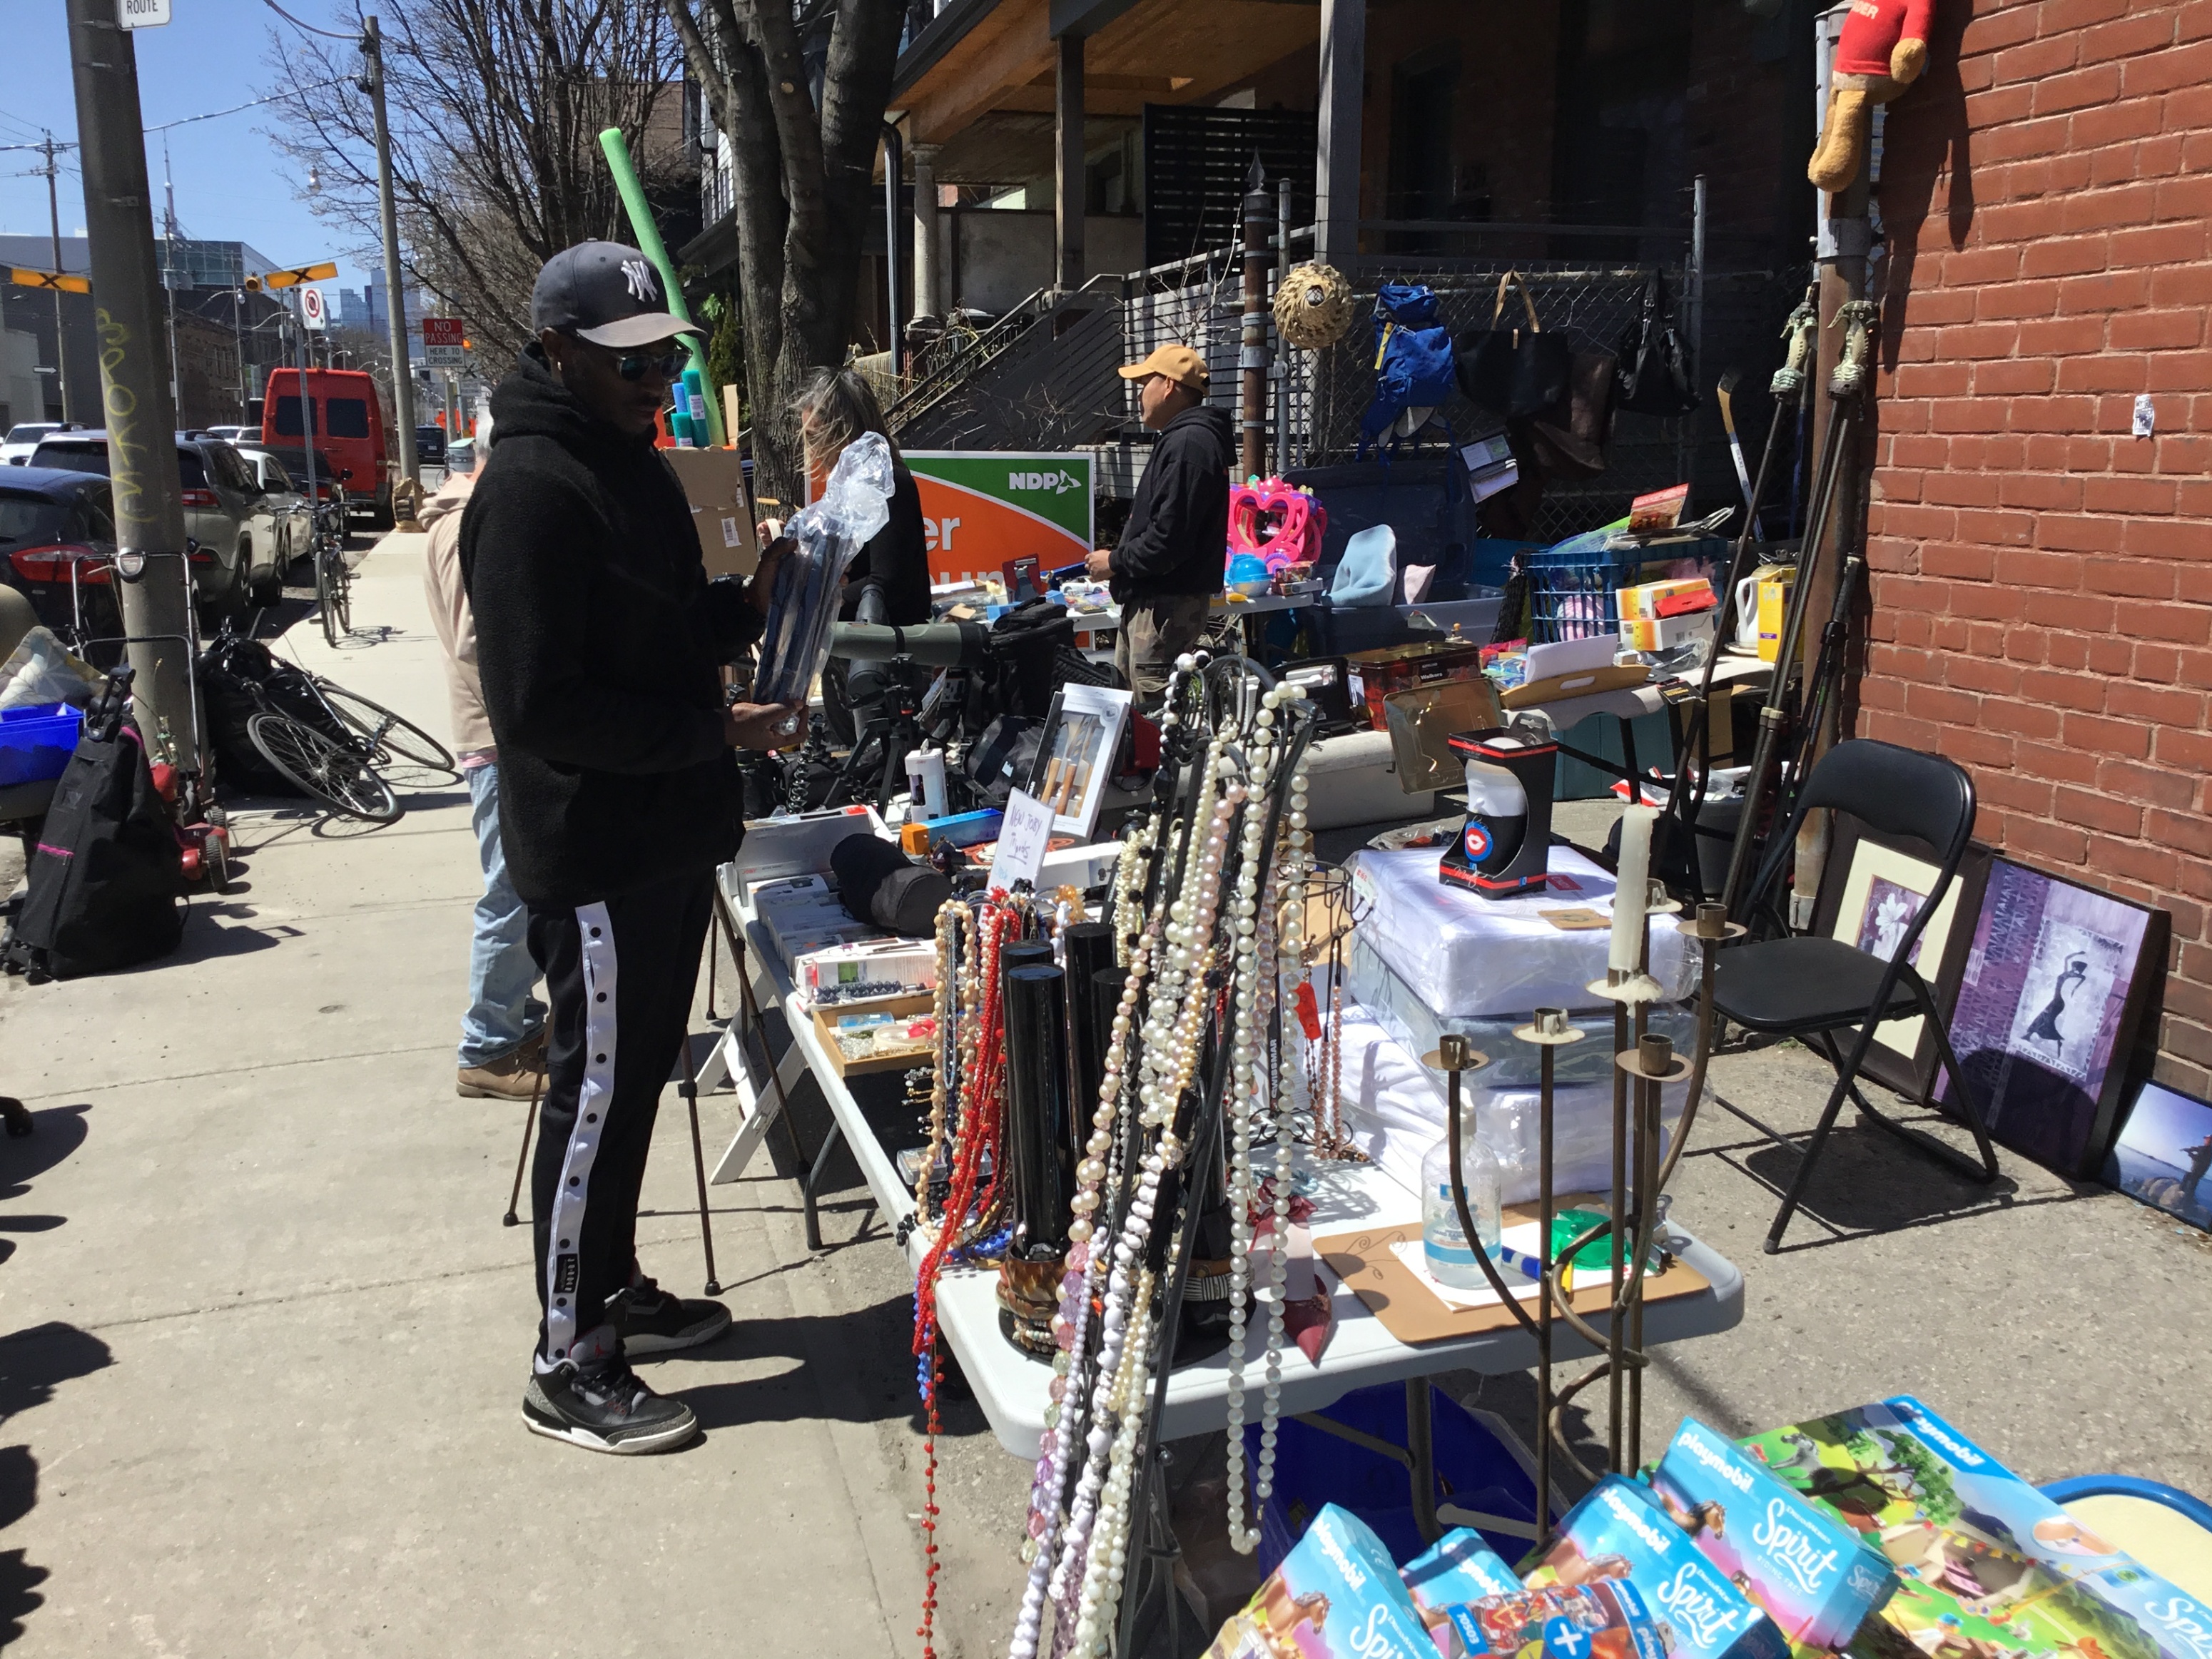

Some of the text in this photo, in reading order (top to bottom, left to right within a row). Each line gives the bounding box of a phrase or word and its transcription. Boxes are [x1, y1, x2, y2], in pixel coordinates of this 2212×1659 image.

[126, 0, 158, 14] ROUTE
[425, 333, 462, 343] PASSING
[434, 321, 451, 333] NO
[1009, 472, 1059, 490] NDP
[1677, 1431, 1755, 1493] playmobil
[1752, 1498, 1838, 1595] Spirit
[1657, 1561, 1739, 1650] Spirit
[1456, 1611, 1481, 1645] 70503
